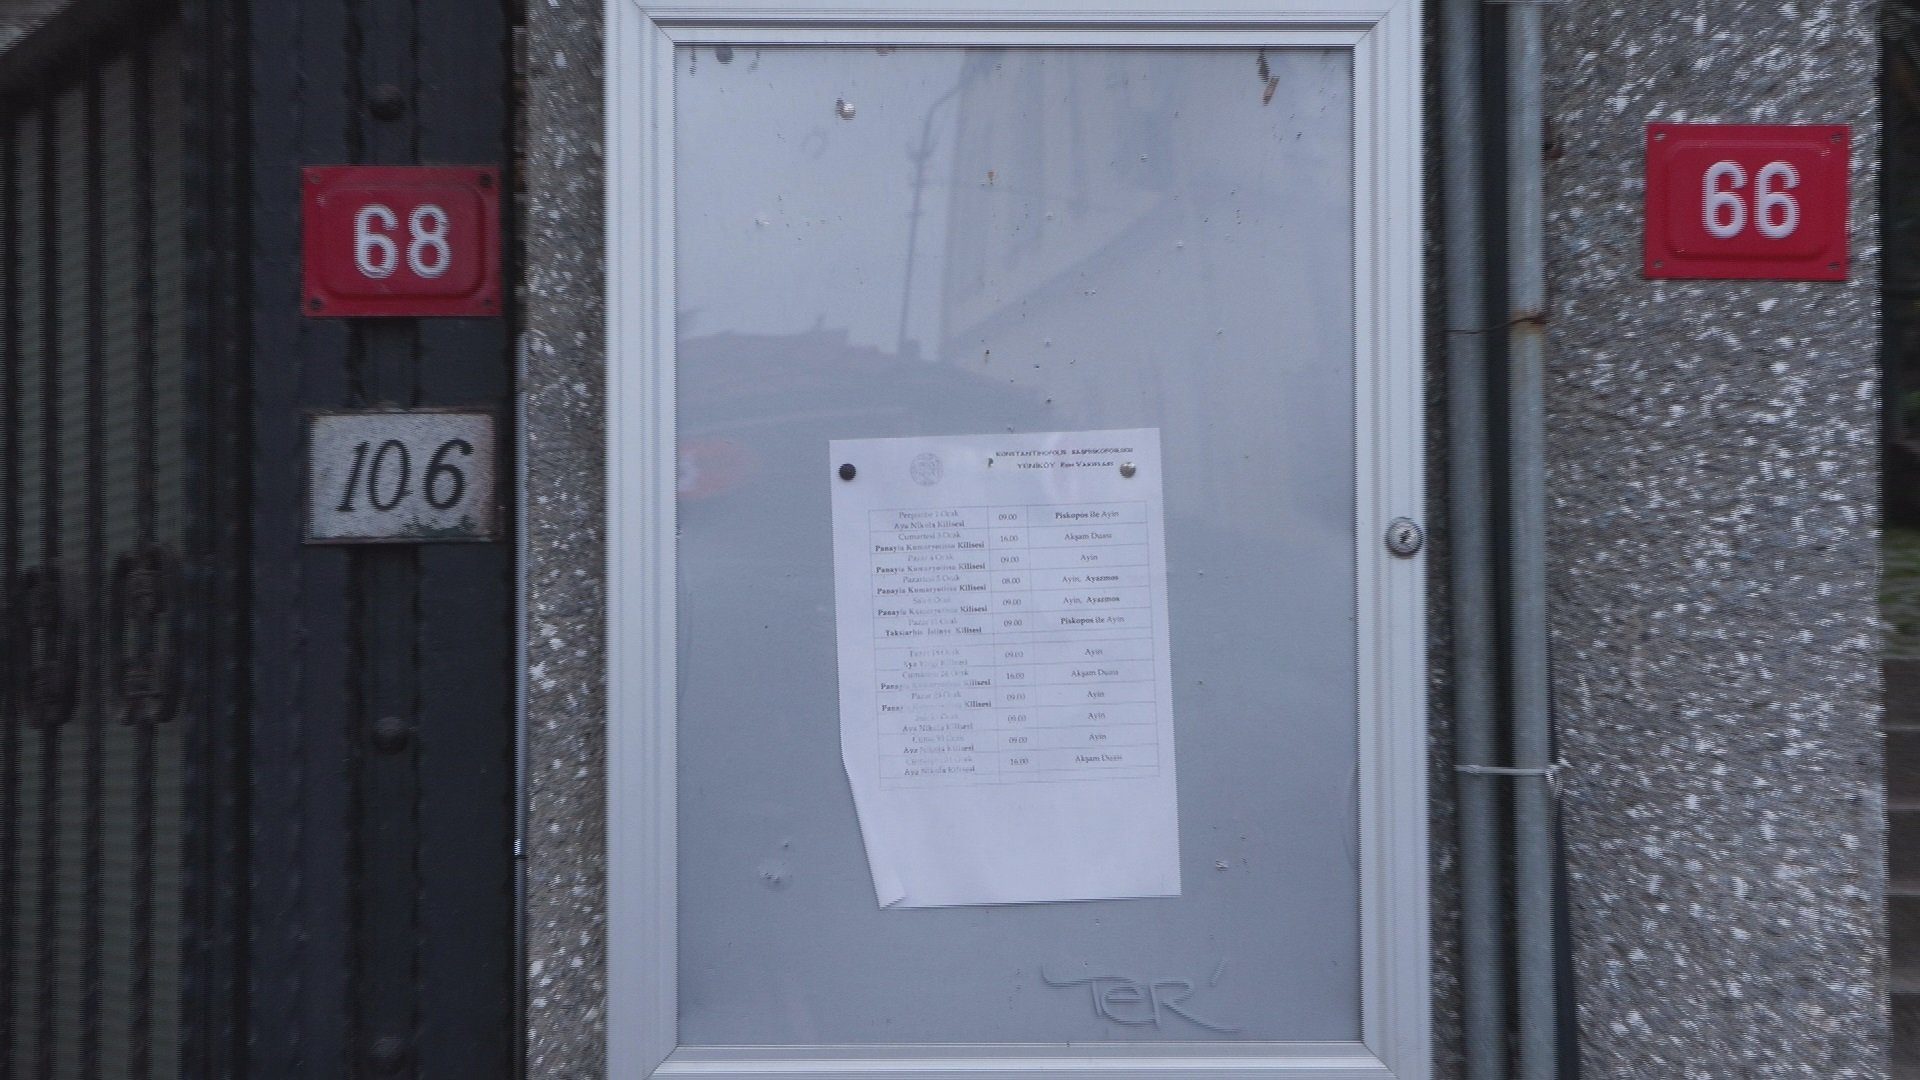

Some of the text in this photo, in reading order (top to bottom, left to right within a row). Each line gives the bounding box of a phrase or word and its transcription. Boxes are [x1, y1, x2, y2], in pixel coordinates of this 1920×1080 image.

[1701, 159, 1801, 240] 66
[353, 203, 452, 280] 68
[337, 438, 474, 513] 106
[998, 513, 1018, 521] 09.00
[1055, 512, 1088, 521] Piskopos
[1064, 533, 1090, 542] Akşam
[957, 541, 985, 549] Kilisesi
[1080, 554, 1098, 562] Ayin
[959, 584, 987, 592] Kilisesi
[960, 605, 988, 613] Kilisesi
[1003, 619, 1023, 627] 09.00
[1060, 617, 1094, 626] Piskopos
